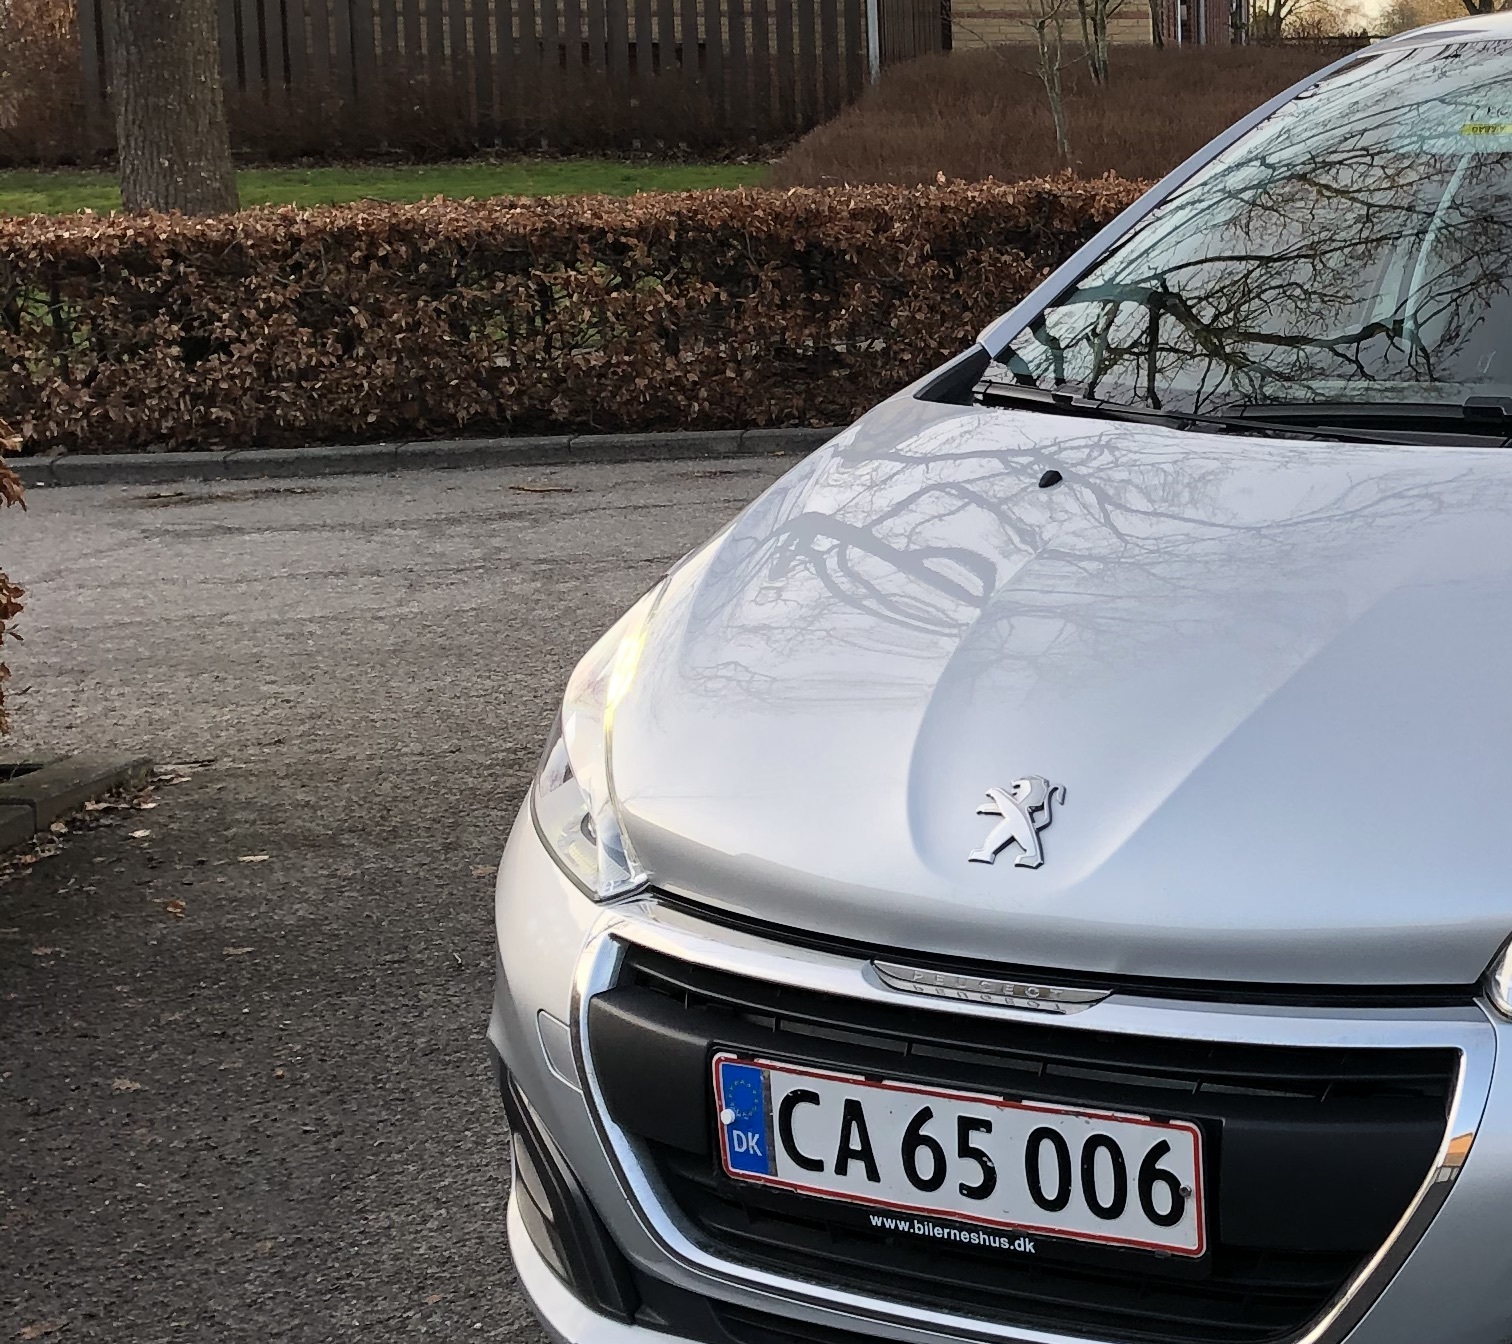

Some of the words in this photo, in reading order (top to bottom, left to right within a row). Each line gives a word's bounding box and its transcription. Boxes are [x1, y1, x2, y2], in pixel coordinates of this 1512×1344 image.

[732, 1129, 763, 1158] DK
[778, 1088, 881, 1184] CA
[901, 1105, 998, 1201] 65
[1024, 1126, 1186, 1228] 006
[869, 1213, 1036, 1255] www.bilerneshus.dk
